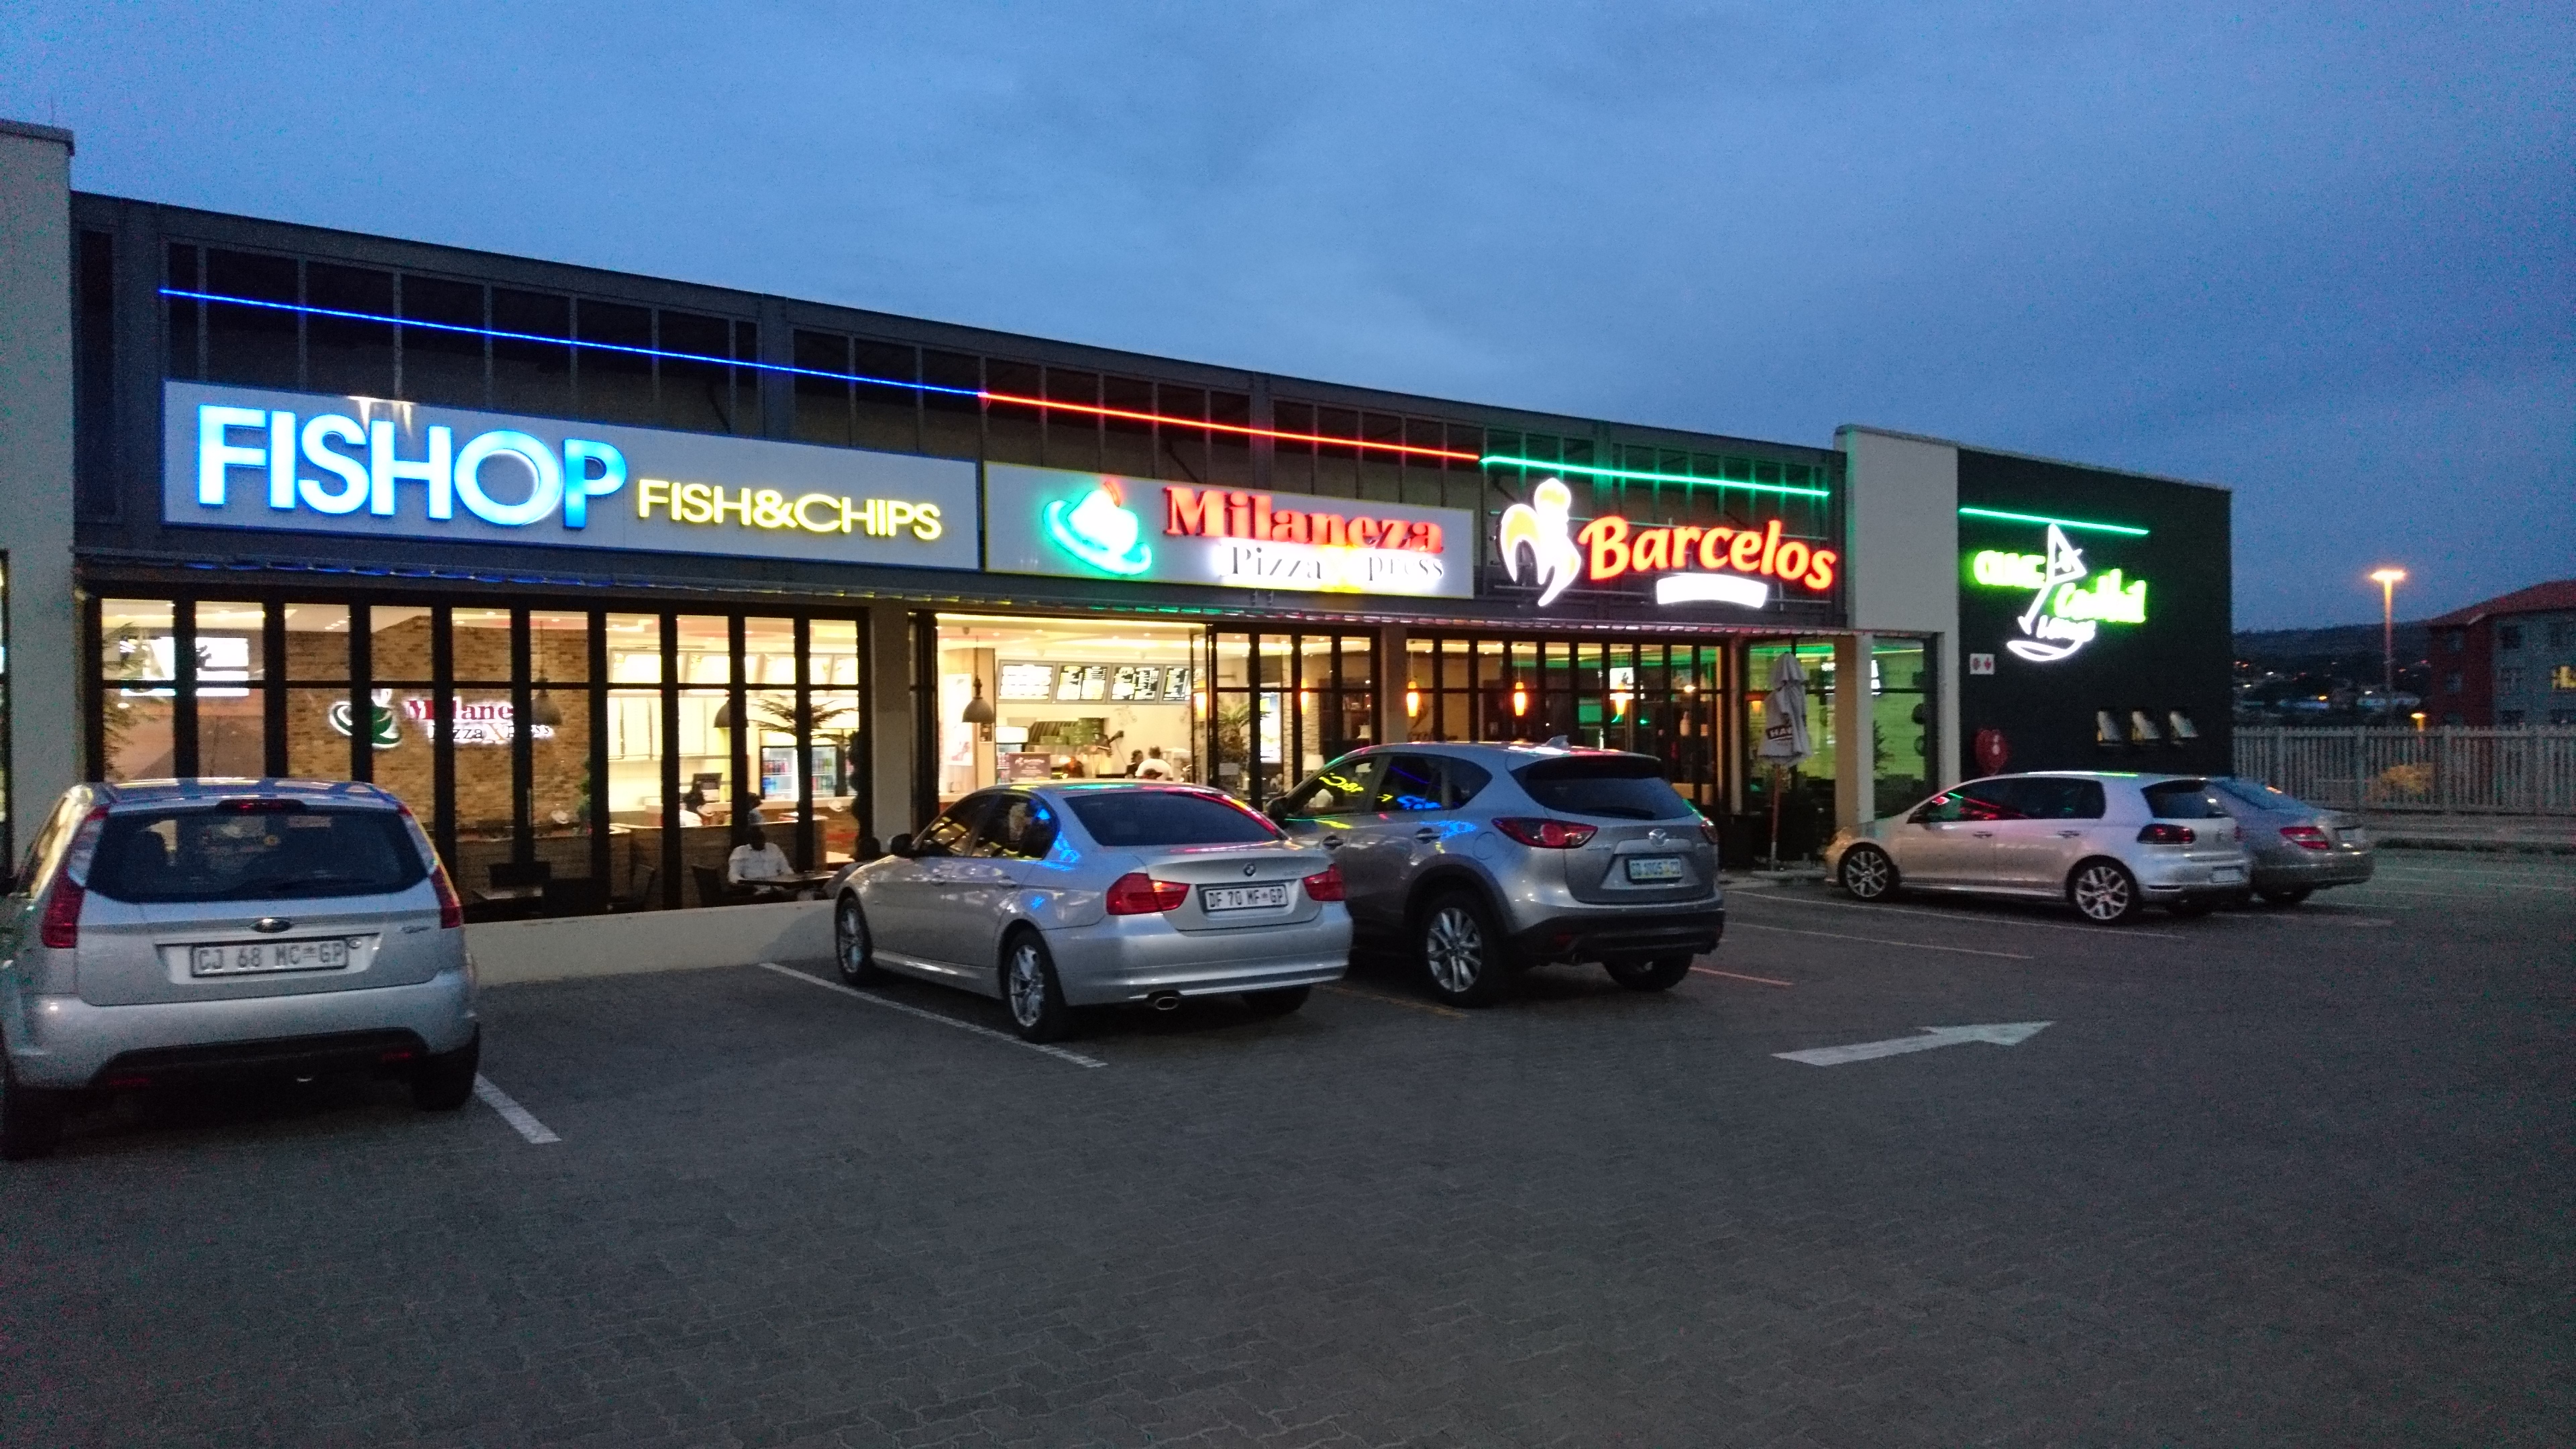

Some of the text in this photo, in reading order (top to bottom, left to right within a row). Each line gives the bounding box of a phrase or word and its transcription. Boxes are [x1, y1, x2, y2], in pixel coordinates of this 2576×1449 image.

[198, 404, 627, 529] FISHOP
[638, 478, 942, 541] FISH&CHIPS
[1163, 486, 1444, 553] Milaneza
[1224, 545, 1322, 580] Pizza
[1578, 515, 1837, 590] Barcelos
[1228, 890, 1242, 906] 70
[1269, 888, 1283, 904] GP
[199, 948, 224, 970] CJ
[237, 947, 261, 968] 68
[319, 943, 343, 963] GP
